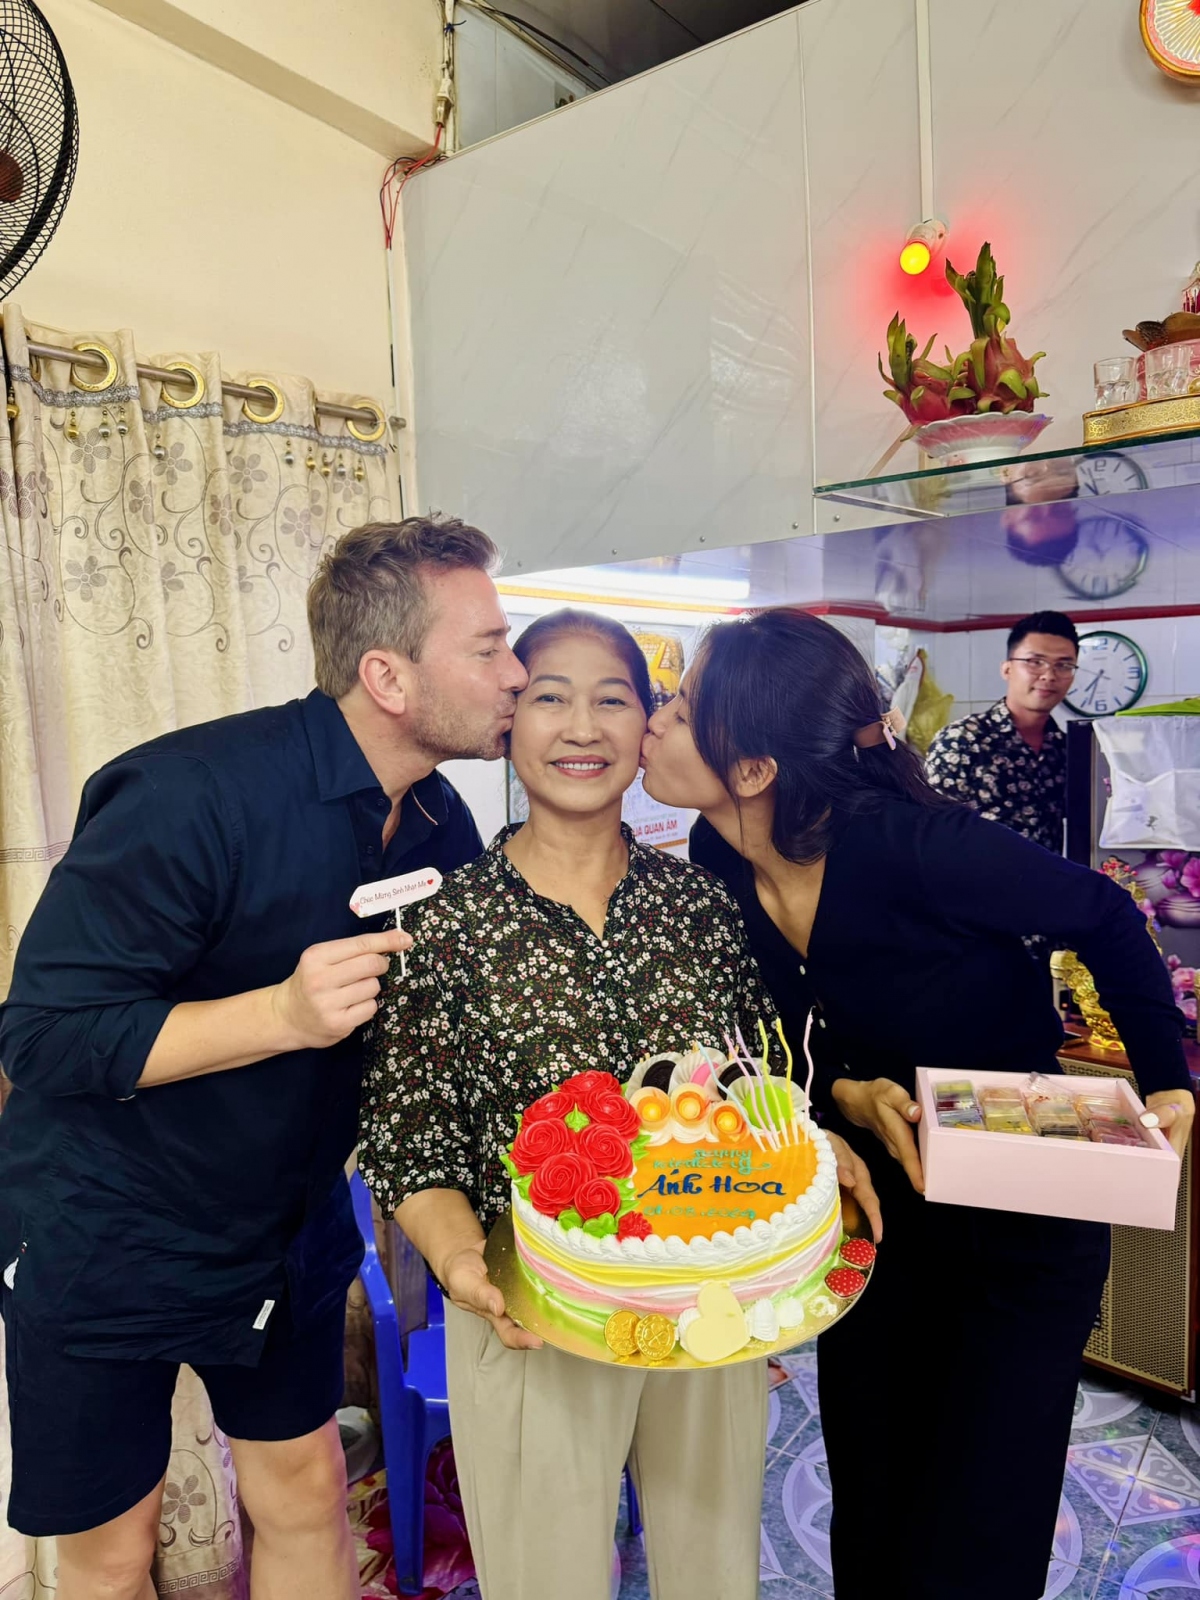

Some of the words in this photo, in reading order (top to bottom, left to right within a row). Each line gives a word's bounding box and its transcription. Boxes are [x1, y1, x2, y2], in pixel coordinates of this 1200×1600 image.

[1127, 666, 1140, 679] 3
[1095, 700, 1107, 711] 6
[644, 821, 665, 835] QUAN
